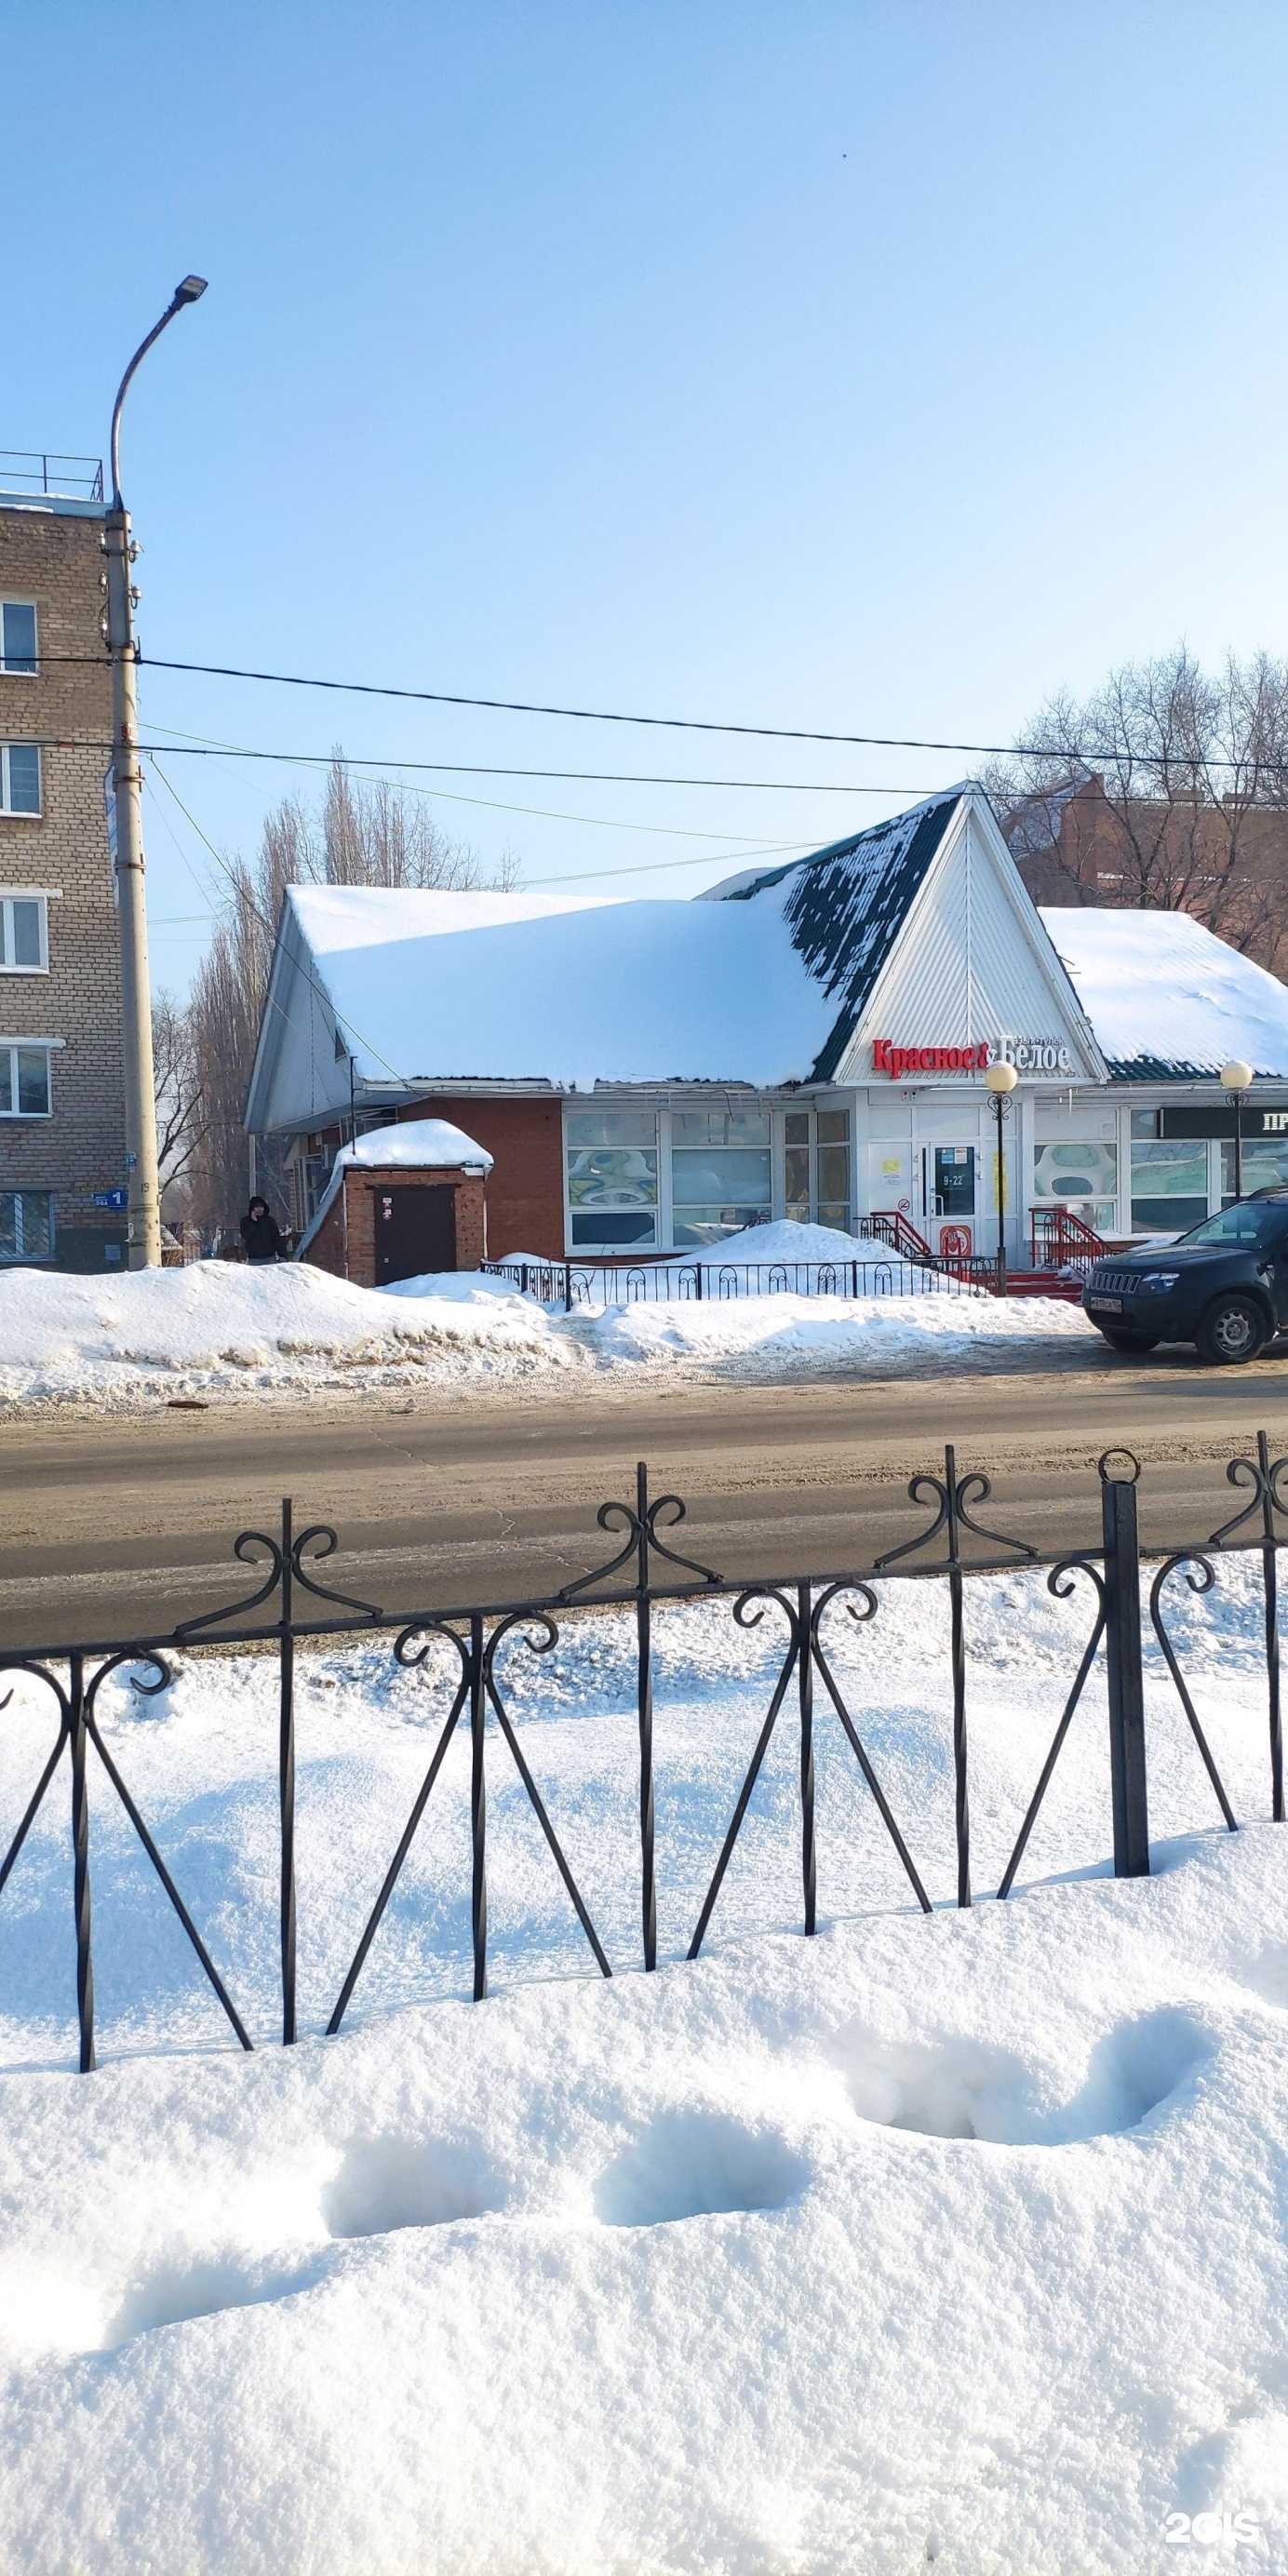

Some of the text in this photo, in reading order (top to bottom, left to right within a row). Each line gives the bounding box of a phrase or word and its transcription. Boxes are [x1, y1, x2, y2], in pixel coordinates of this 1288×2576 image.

[872, 1039, 976, 1080] Красное
[1000, 1035, 1071, 1070] Белое
[112, 1191, 121, 1204] 1
